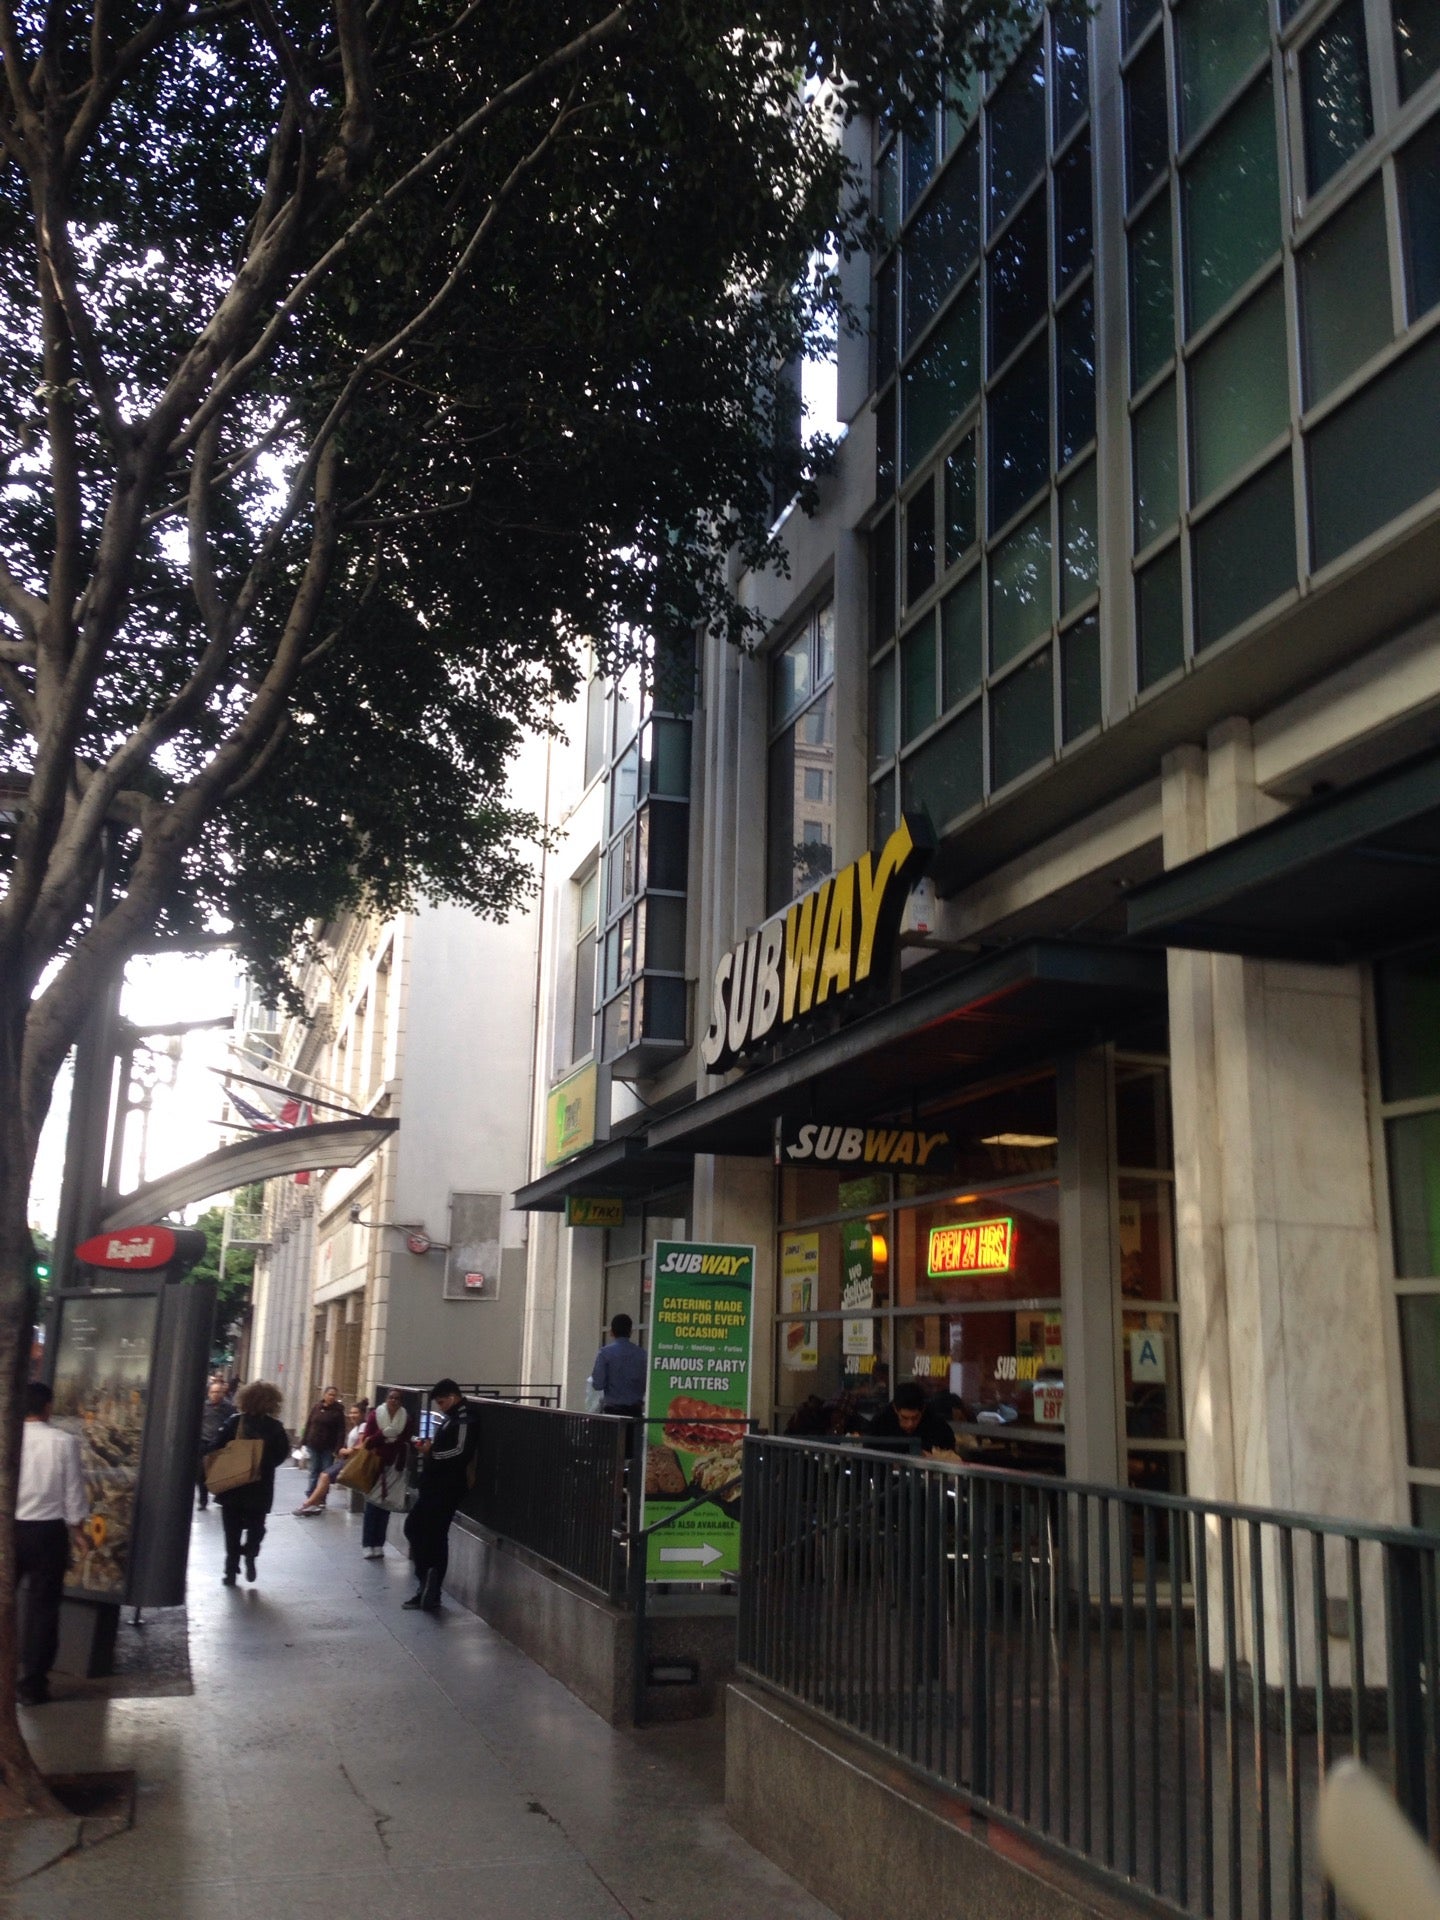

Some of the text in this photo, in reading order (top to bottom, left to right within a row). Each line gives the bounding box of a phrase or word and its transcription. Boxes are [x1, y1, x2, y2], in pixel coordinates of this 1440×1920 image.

[701, 813, 914, 1066] SUBWAY
[786, 1124, 949, 1166] SUBWAY
[105, 1237, 155, 1263] Rapid
[931, 1229, 961, 1272] OPEN
[962, 1228, 977, 1268] 24
[659, 1252, 750, 1276] SUBWAY
[663, 1297, 743, 1313] CATERING MADE
[658, 1311, 746, 1326] FRESH FOR EVERY
[675, 1326, 728, 1339] OCCASION!
[1139, 1340, 1158, 1365] A
[654, 1357, 746, 1373] FAMOUS PARTY
[844, 1354, 877, 1375] SUBWAY
[912, 1355, 952, 1377] SUBWAY
[994, 1355, 1045, 1381] SUBWAY
[669, 1375, 730, 1391] PLATTERS
[1043, 1401, 1062, 1420] EBT
[677, 1520, 695, 1529] ALSO
[697, 1520, 735, 1529] AVAILABLE
